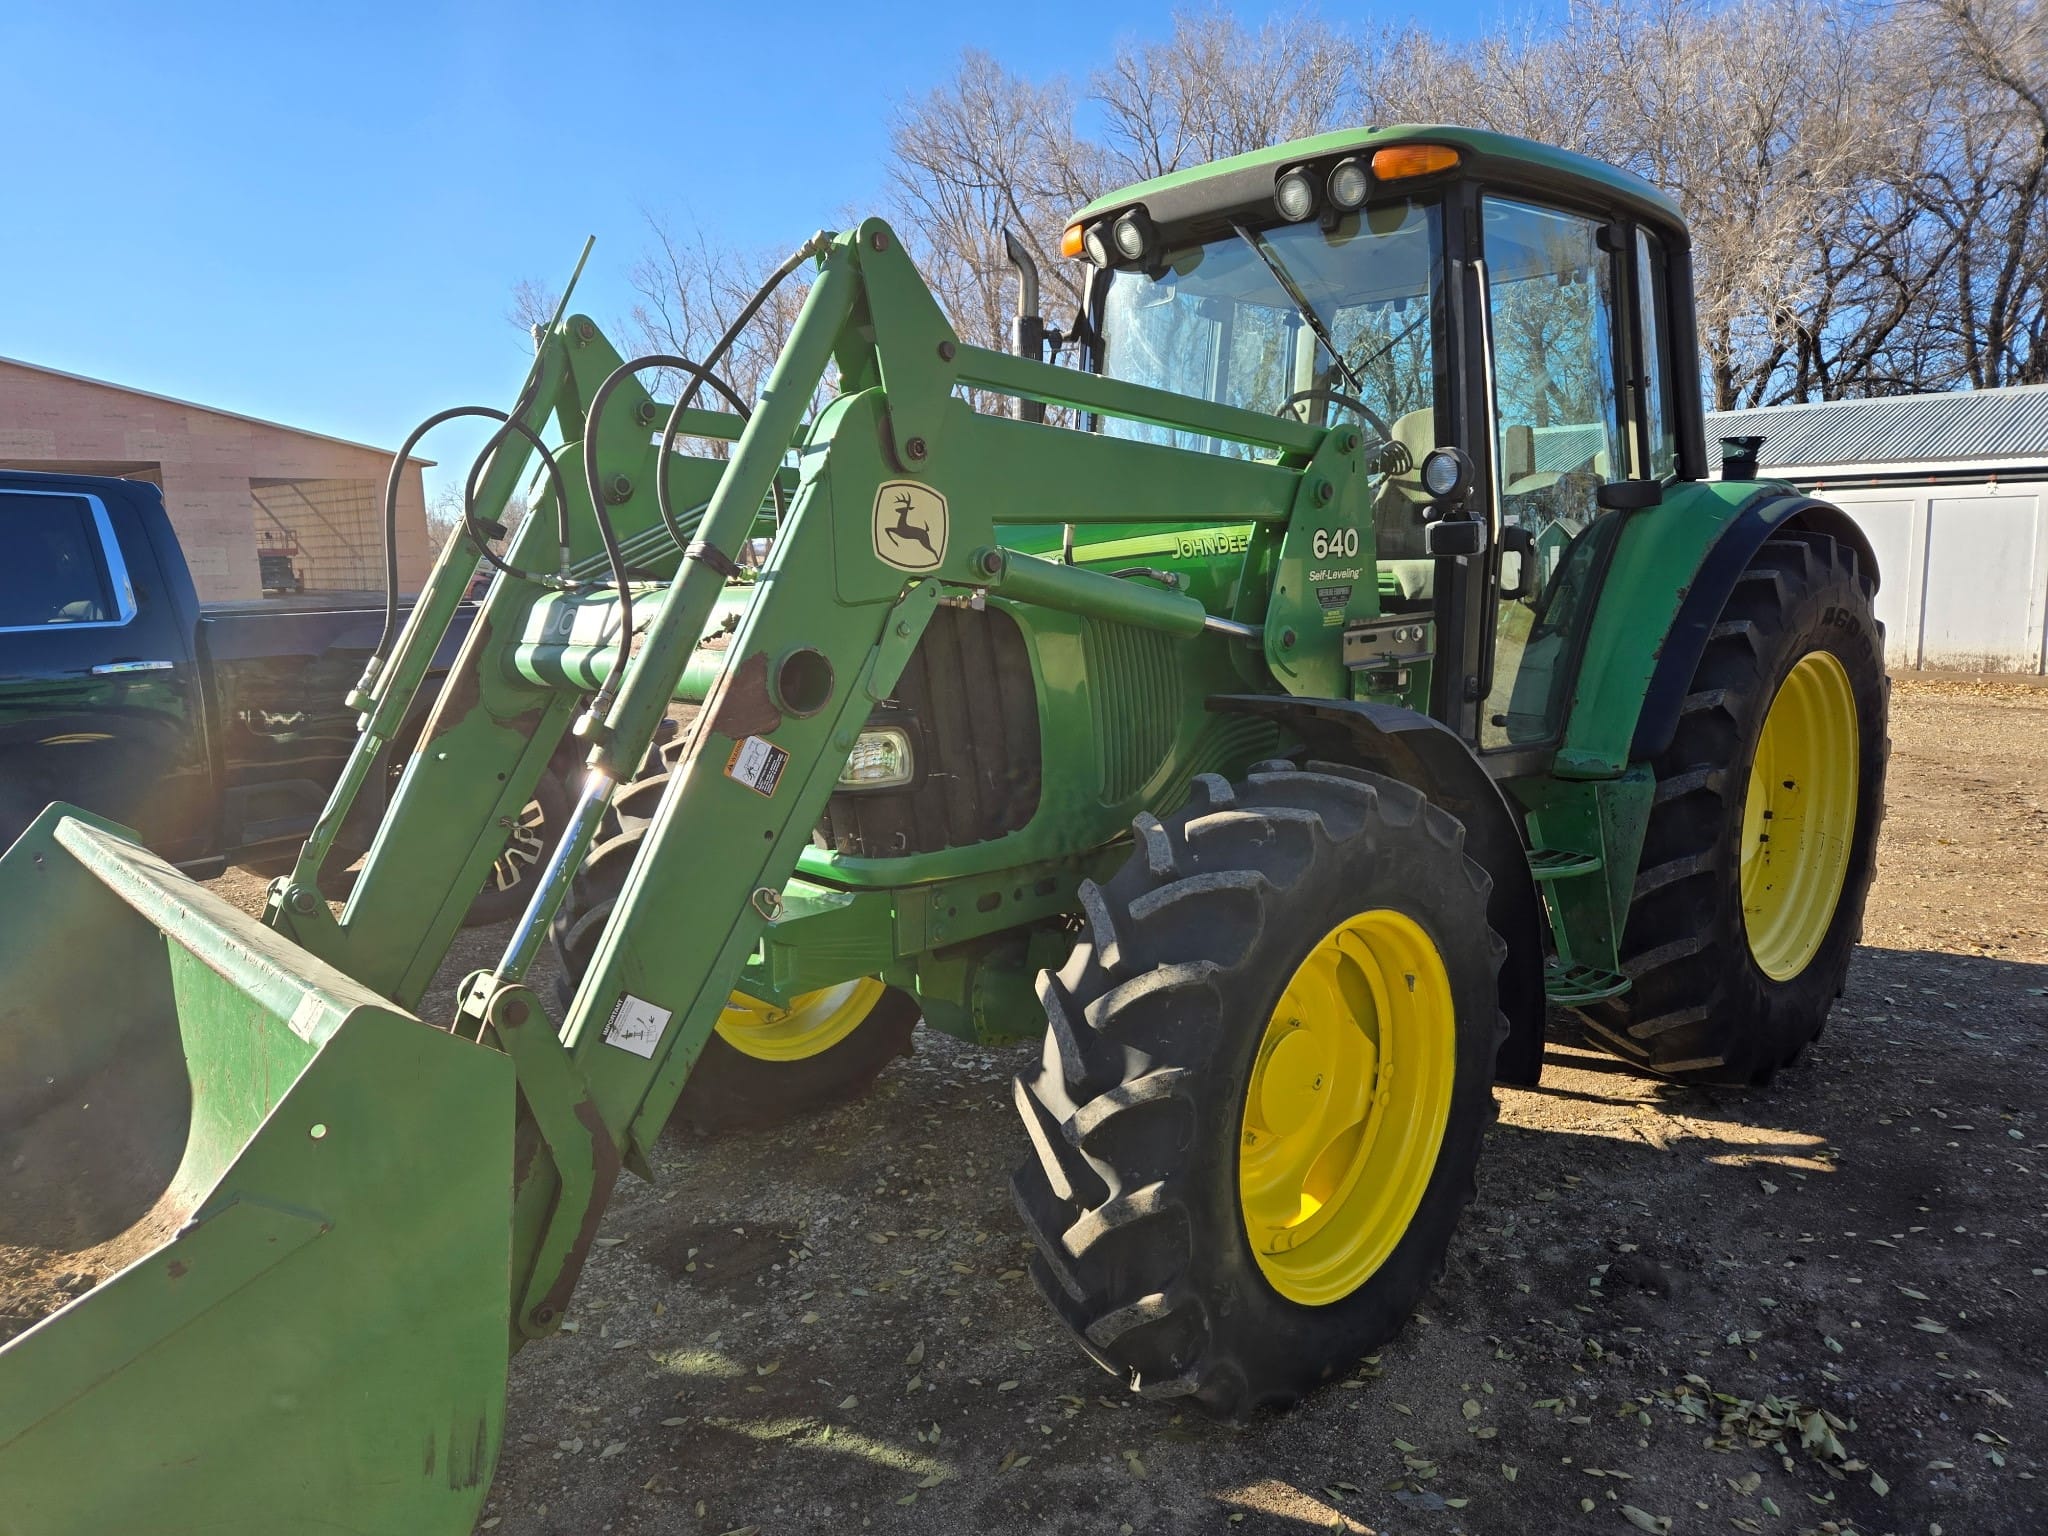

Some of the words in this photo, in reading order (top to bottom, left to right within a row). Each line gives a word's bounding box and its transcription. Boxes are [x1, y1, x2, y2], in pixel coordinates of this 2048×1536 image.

[1215, 532, 1250, 554] DEE
[1312, 528, 1359, 560] 640
[602, 998, 624, 1036] IMPORTANT
